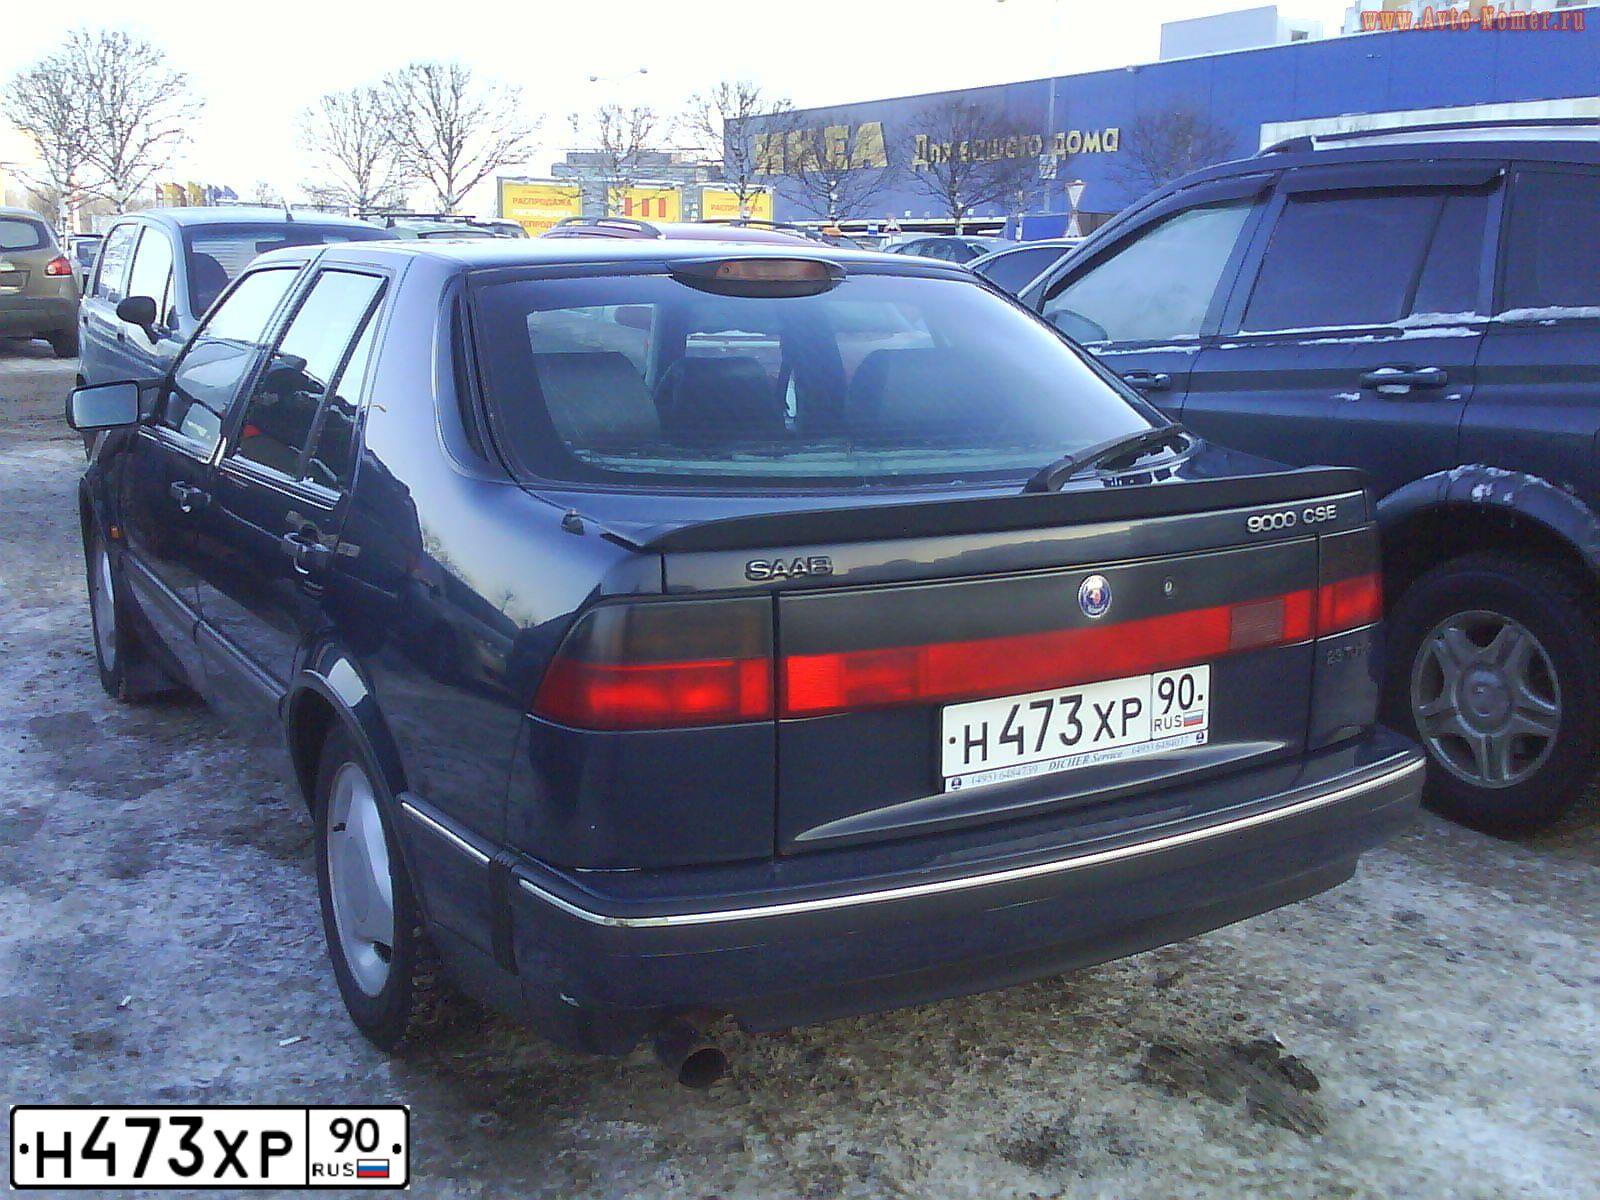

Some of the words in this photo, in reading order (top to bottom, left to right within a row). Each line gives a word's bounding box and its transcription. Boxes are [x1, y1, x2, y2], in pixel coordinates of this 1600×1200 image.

[1053, 127, 1119, 160] дома
[1248, 511, 1297, 533] 9000
[1303, 504, 1337, 524] CSE
[745, 555, 834, 581] SAAB
[1157, 673, 1195, 714] 90
[1153, 718, 1182, 732] RUS
